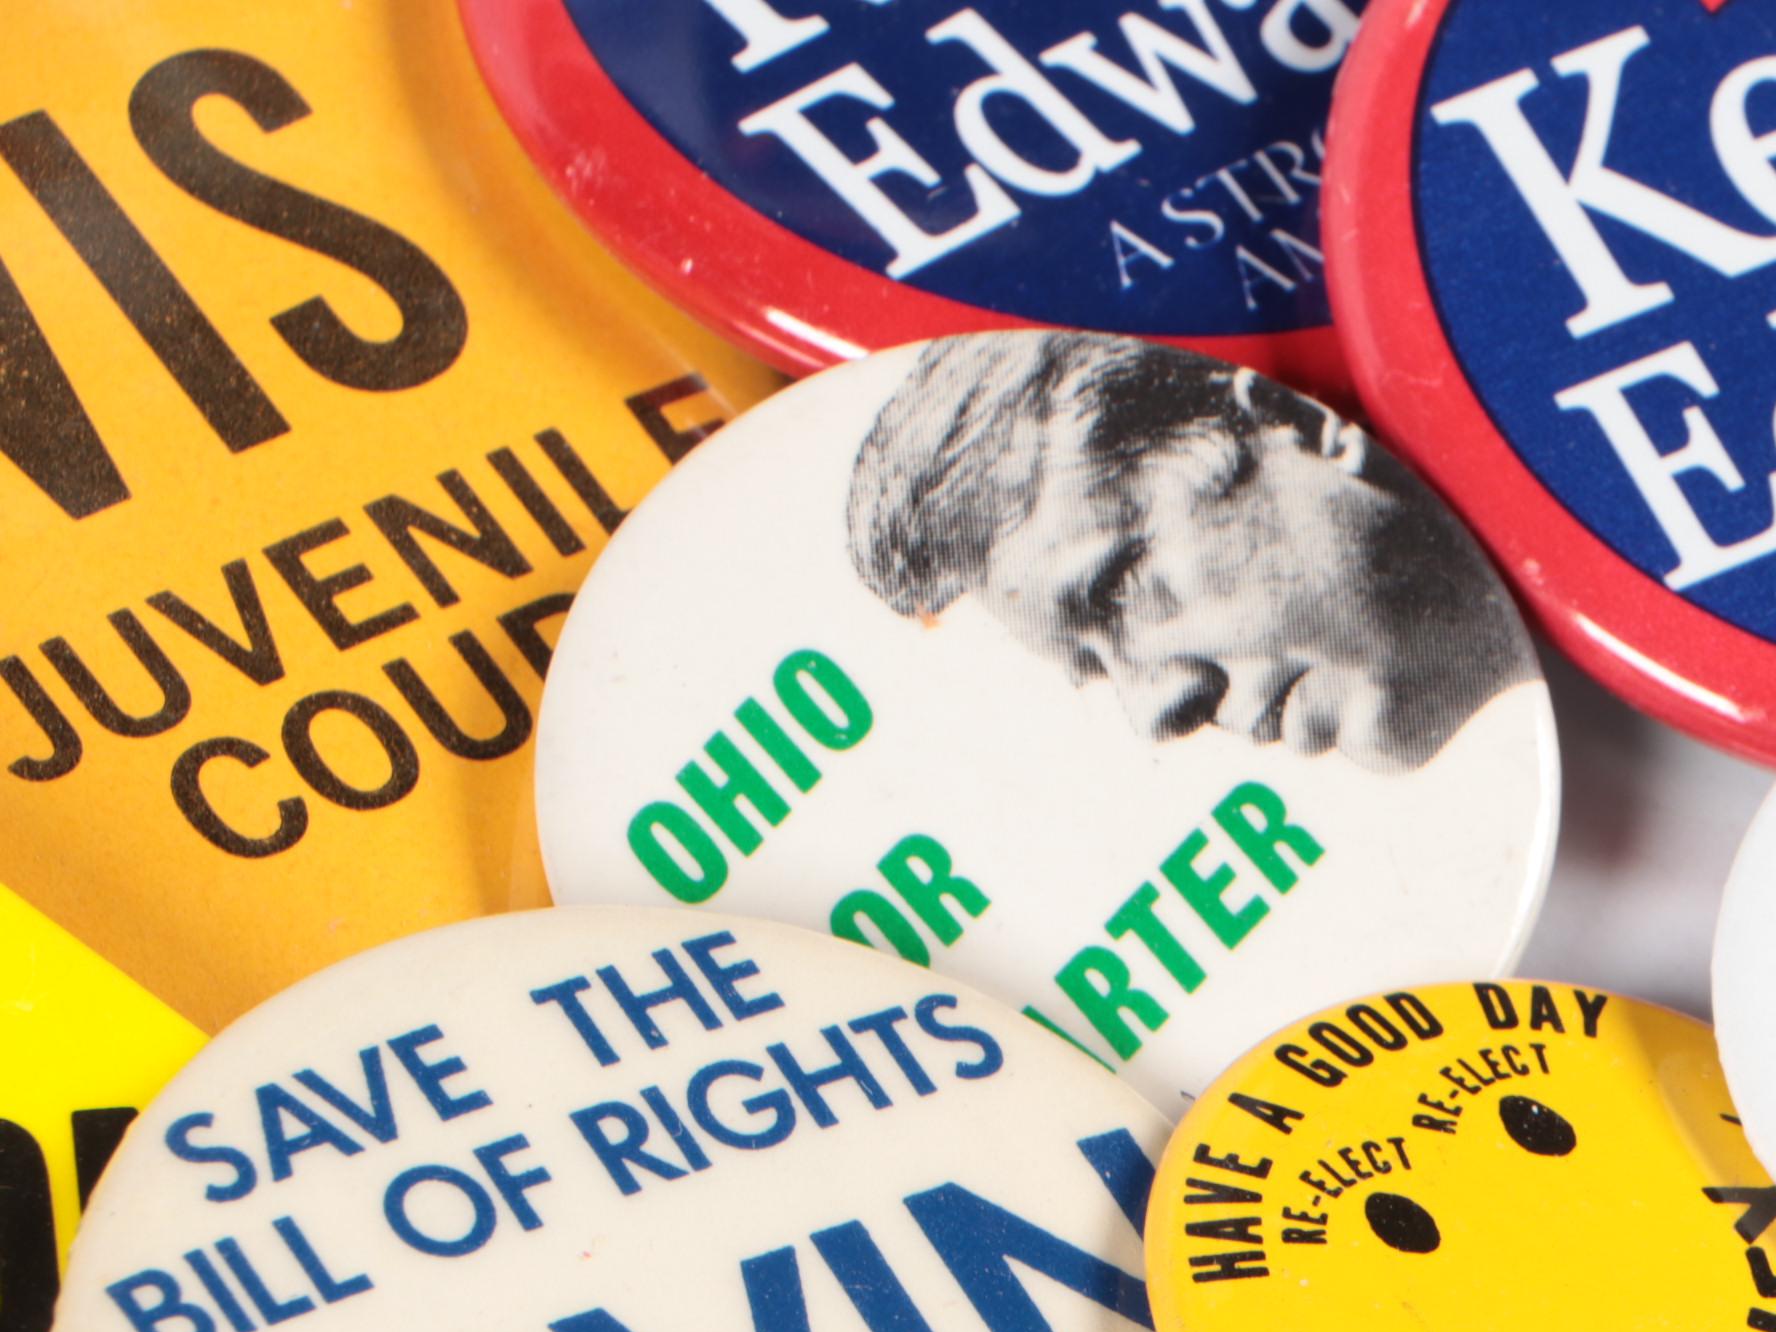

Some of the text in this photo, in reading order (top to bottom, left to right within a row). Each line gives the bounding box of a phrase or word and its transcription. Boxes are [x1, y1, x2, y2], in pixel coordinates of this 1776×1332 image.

[1161, 130, 1325, 249] STR
[626, 649, 874, 903] OHIO
[1022, 780, 1327, 1075] RTER
[165, 930, 786, 1204] SAVE THE
[382, 1132, 552, 1258] OF
[568, 994, 1004, 1197] RIGHTS
[1184, 983, 1608, 1285] HAVE A GOOD DAY
[1281, 1136, 1415, 1246] RE-ELECT
[1412, 1042, 1552, 1135] RE-ELECT
